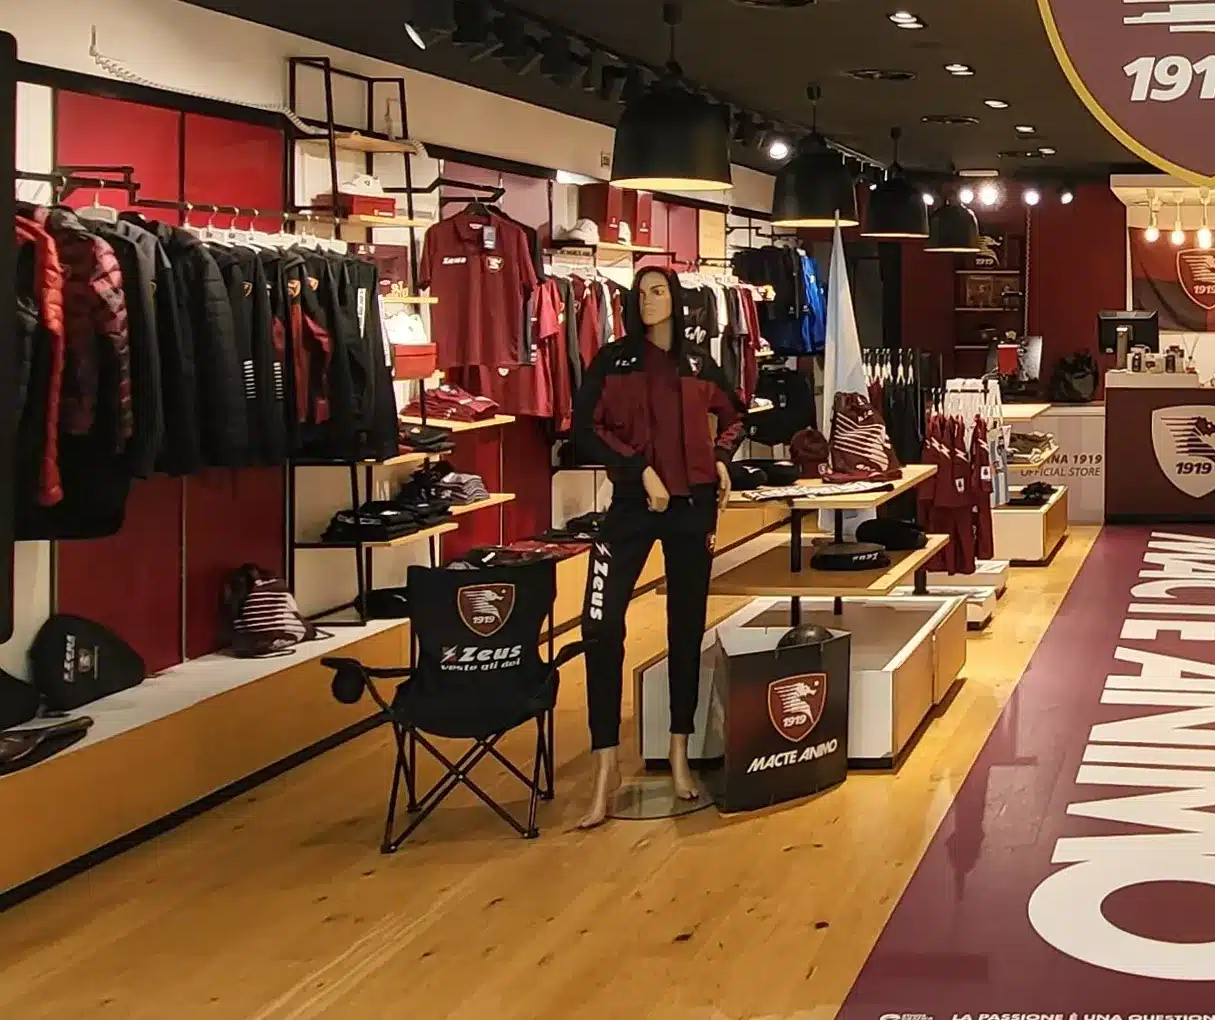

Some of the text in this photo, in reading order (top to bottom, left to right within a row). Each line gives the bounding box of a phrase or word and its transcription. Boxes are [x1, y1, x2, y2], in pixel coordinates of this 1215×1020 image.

[1073, 454, 1103, 464] 1919
[1068, 467, 1101, 477] STORE
[1176, 461, 1213, 475] 1919
[590, 560, 609, 621] Zeus
[472, 615, 495, 624] 1919
[458, 645, 522, 662] Zeus
[782, 714, 807, 728] 1919
[746, 738, 838, 773] MACTE ANIMO
